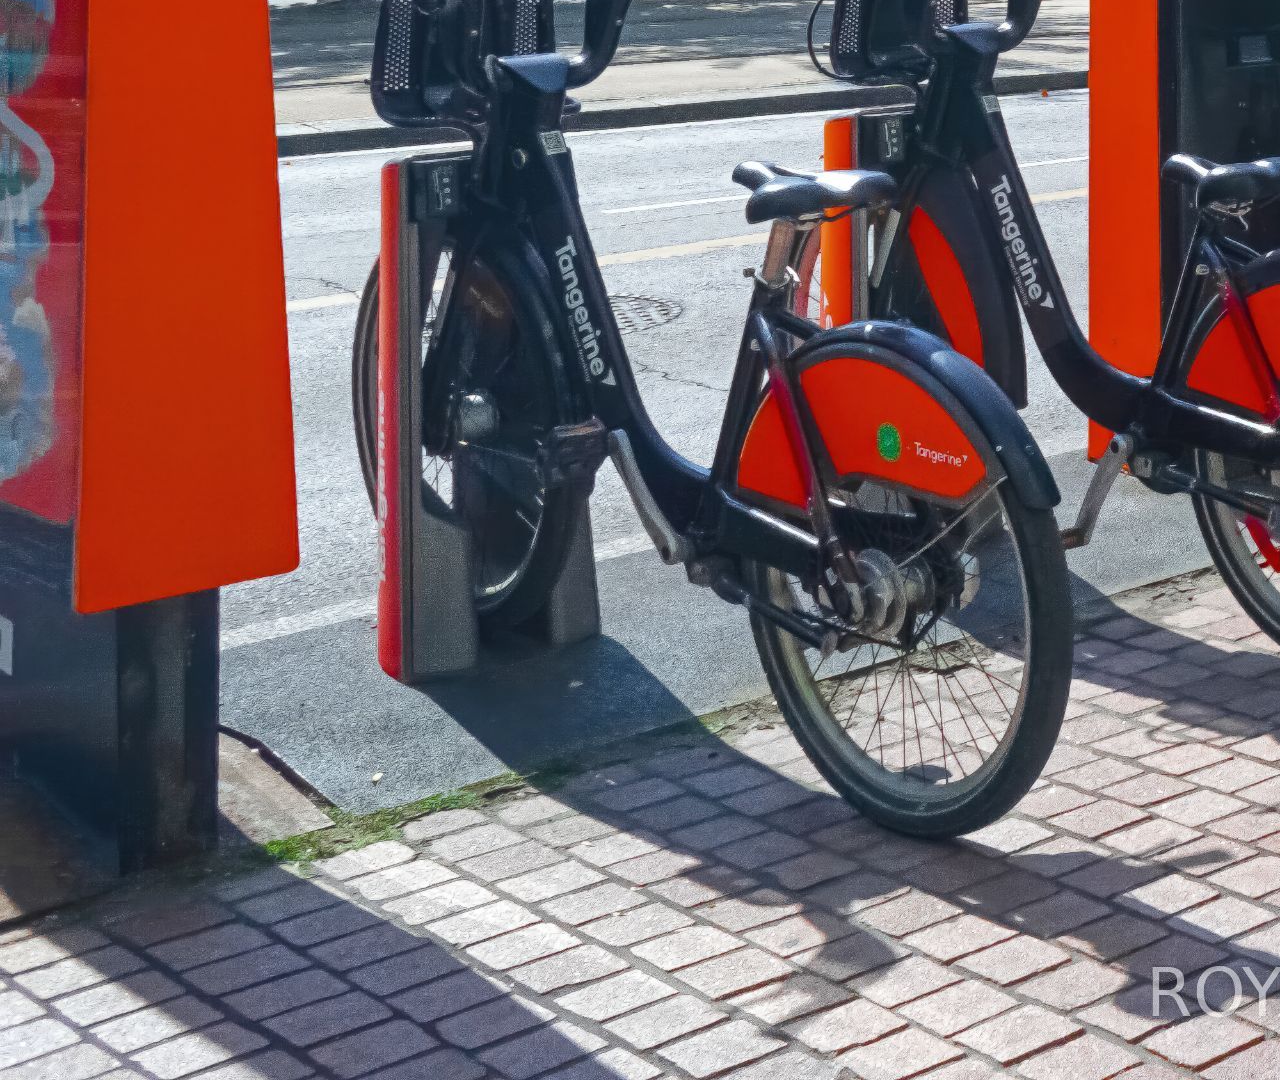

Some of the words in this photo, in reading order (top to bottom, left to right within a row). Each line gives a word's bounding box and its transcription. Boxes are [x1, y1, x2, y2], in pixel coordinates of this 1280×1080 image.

[990, 174, 1042, 300] Tangerine
[554, 235, 605, 376] Tangerine
[914, 441, 962, 467] Tangerine
